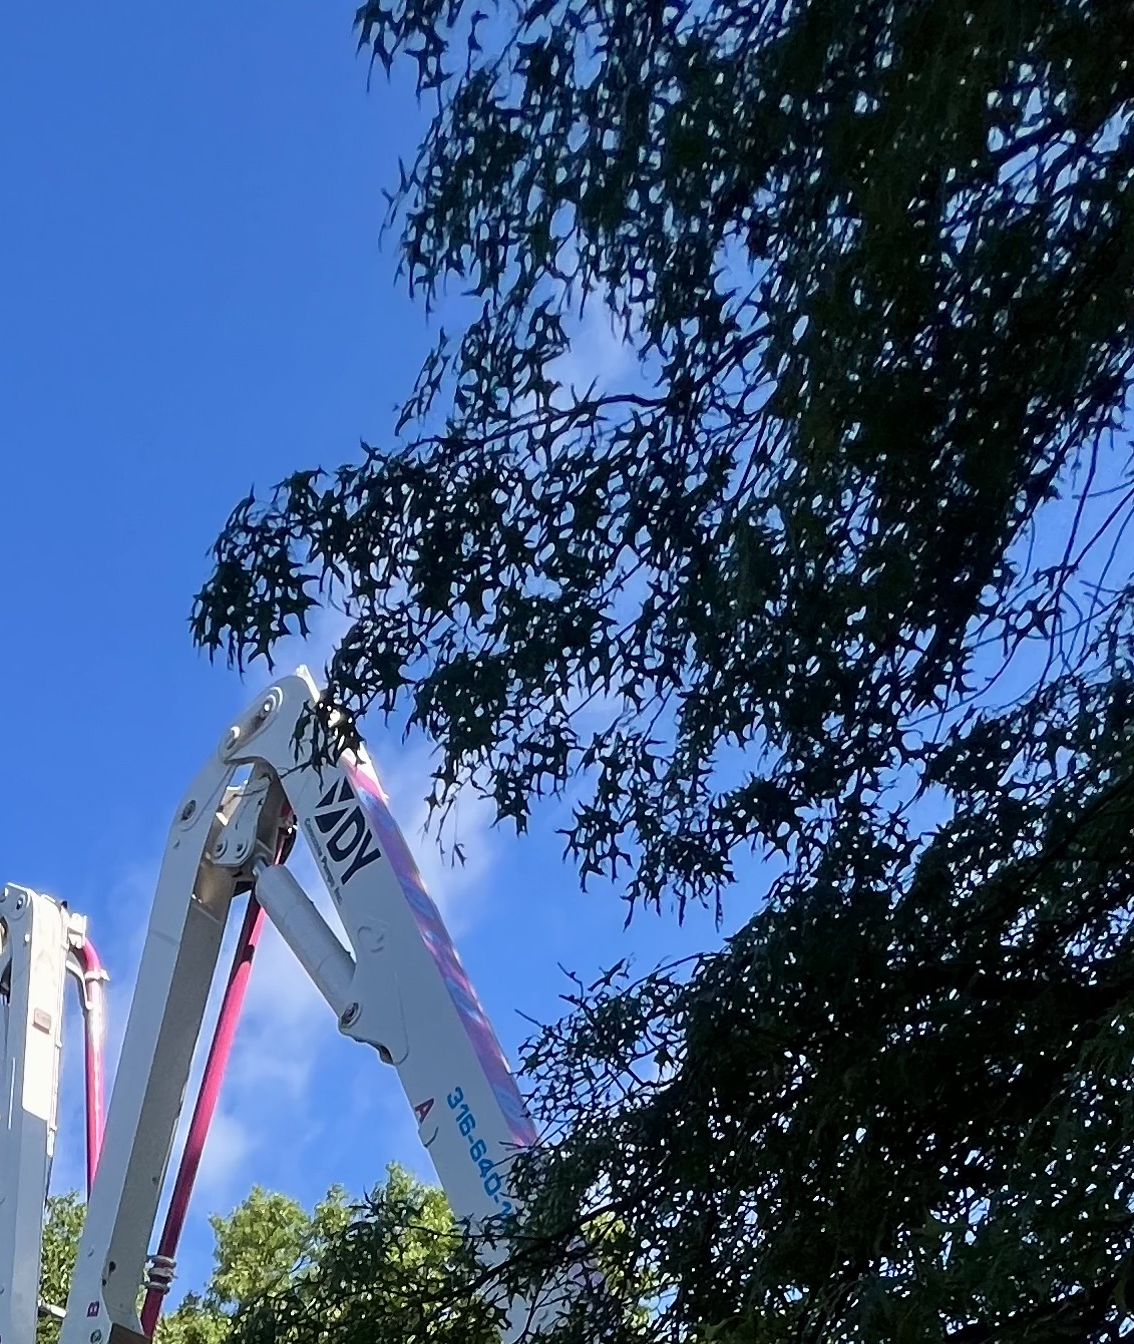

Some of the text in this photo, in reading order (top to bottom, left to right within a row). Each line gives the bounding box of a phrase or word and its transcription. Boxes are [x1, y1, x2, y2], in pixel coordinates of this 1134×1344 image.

[414, 1098, 435, 1125] A
[446, 1086, 512, 1215] 316-640-1
[86, 1301, 100, 1318] B
